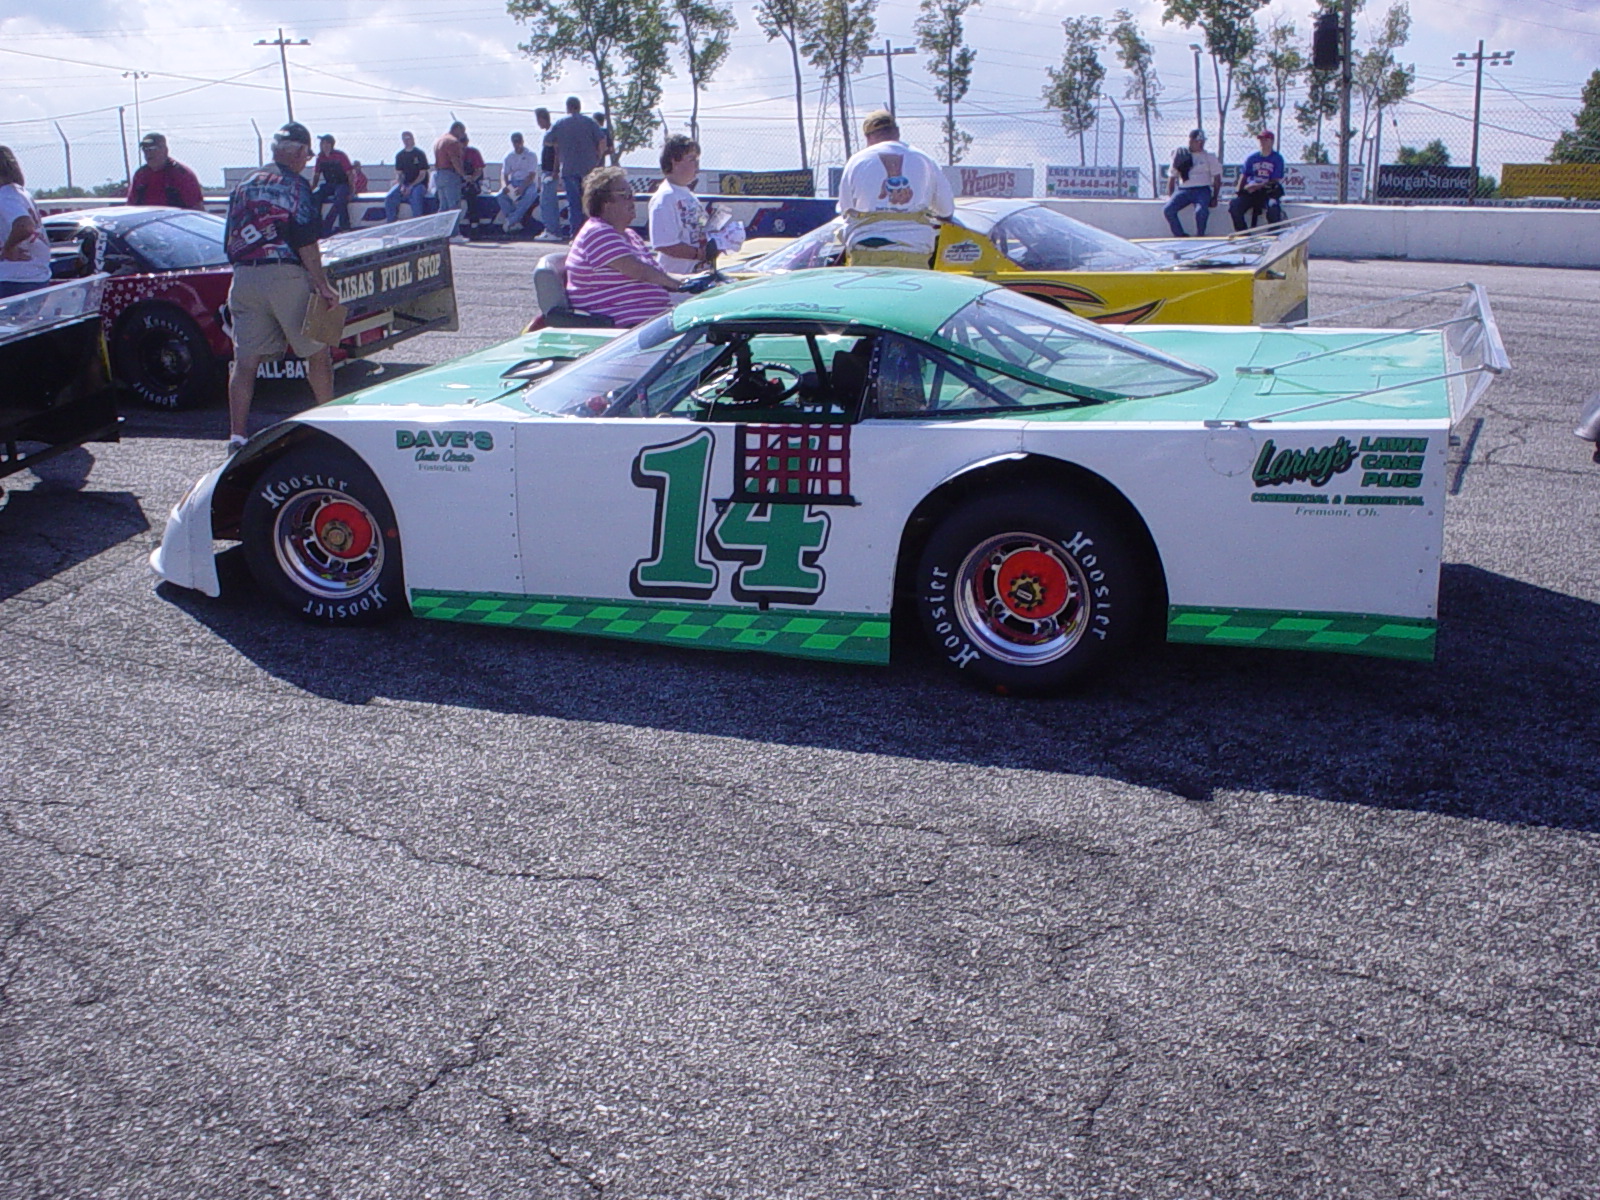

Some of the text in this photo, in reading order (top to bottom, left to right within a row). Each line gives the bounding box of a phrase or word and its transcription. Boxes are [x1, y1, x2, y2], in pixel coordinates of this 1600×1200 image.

[1072, 169, 1097, 179] TREE
[1099, 170, 1138, 180] SERICE
[336, 253, 441, 304] LISA'S FUEL STOP
[396, 430, 494, 451] DAVE'S
[1359, 436, 1429, 453] LAWN
[415, 448, 440, 462] Auto
[1252, 436, 1360, 487] Larry's
[1361, 454, 1425, 470] CARE
[1361, 472, 1423, 488] PLUS
[261, 474, 348, 509] Hoosier
[1251, 493, 1330, 504] COMMERCIAL
[1344, 495, 1425, 506] RESIDENTIAL
[629, 426, 832, 605] 14
[1295, 507, 1380, 517] Fremont, Oh.
[1062, 531, 1111, 641] Hoosier
[303, 583, 387, 618] Hoosier
[924, 566, 980, 669] Hoosier
